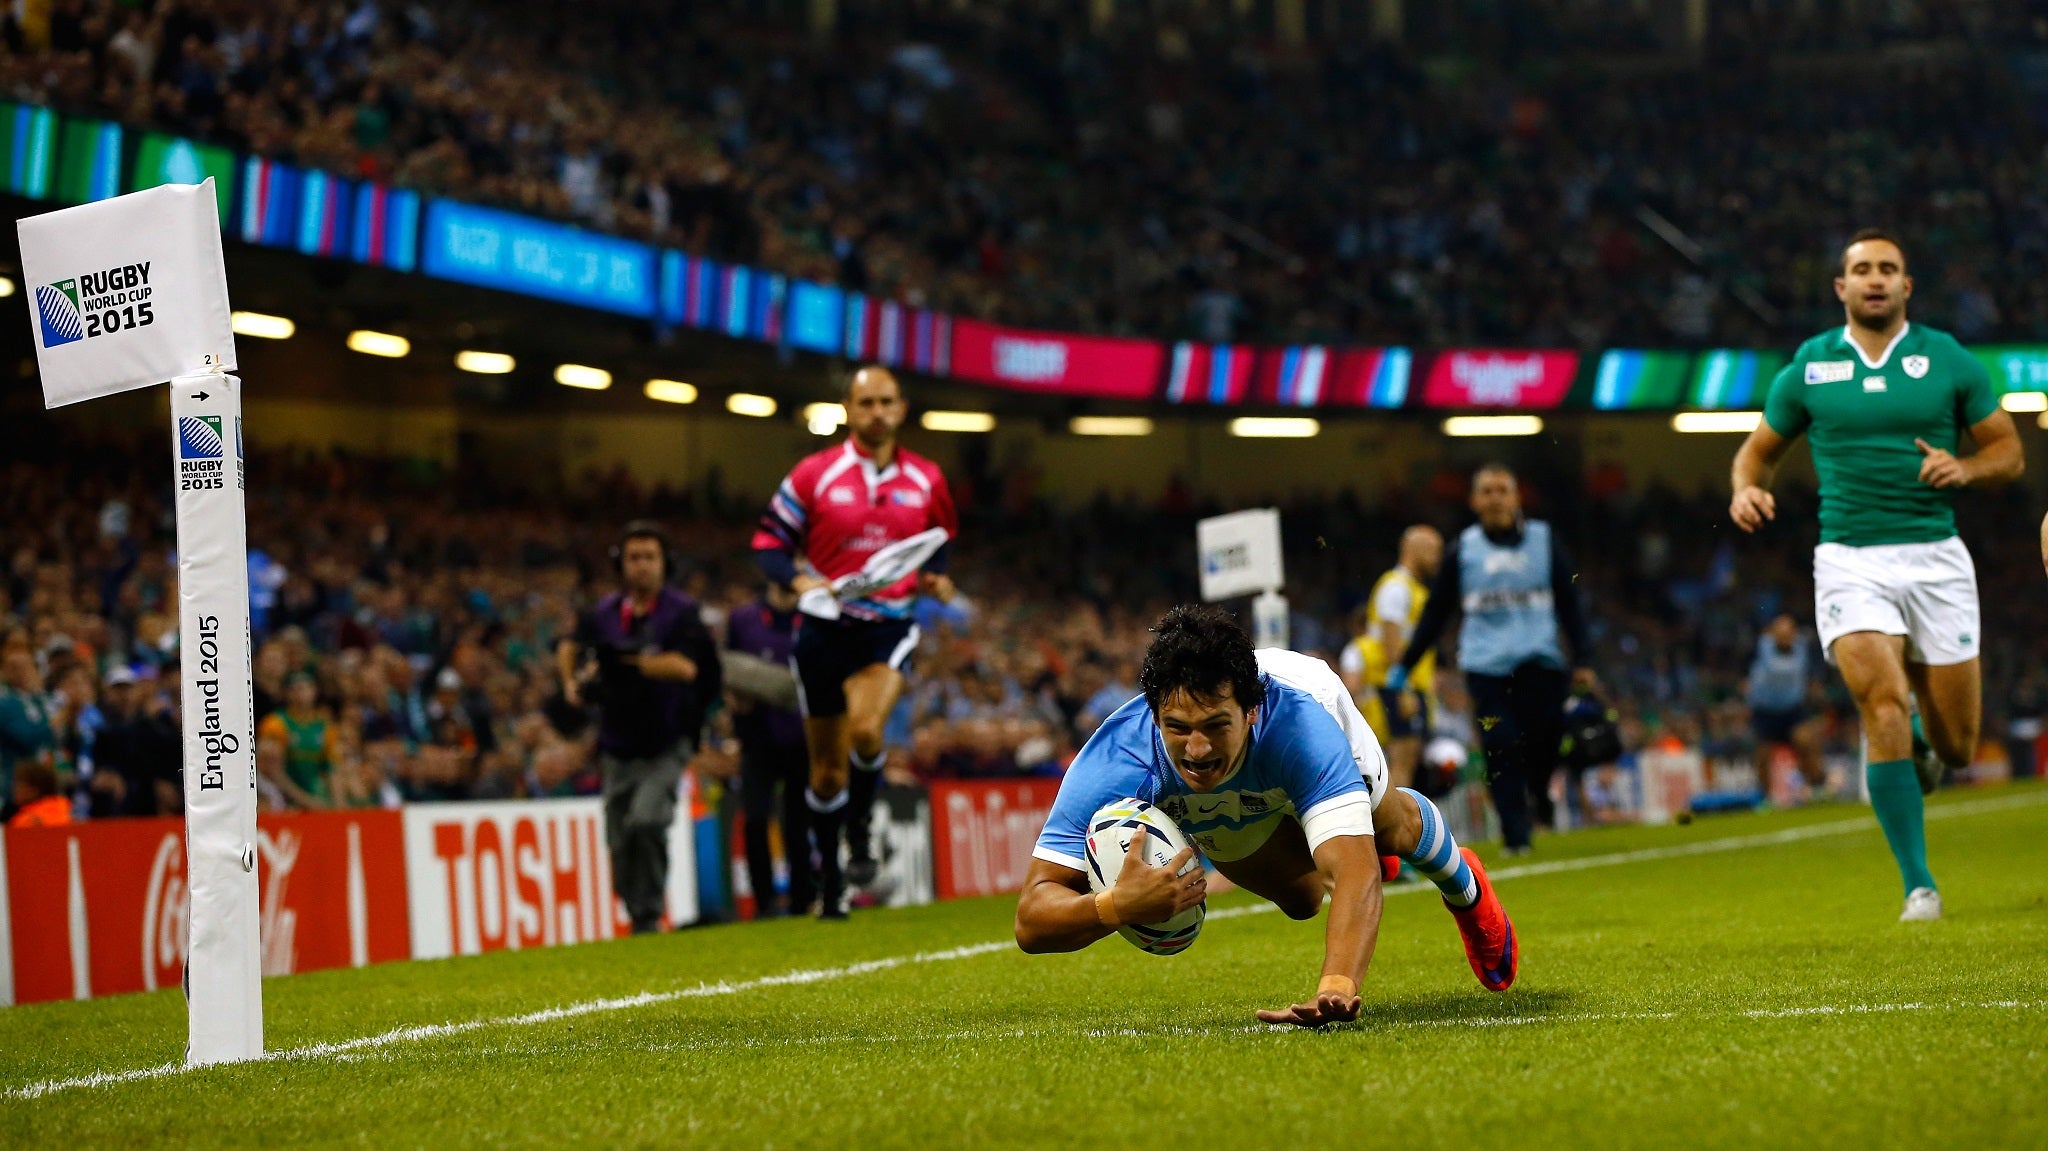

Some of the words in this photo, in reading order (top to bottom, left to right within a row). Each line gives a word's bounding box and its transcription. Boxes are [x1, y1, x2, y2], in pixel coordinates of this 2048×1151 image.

[62, 282, 75, 291] IRB
[80, 261, 150, 298] RUGBY
[83, 292, 126, 312] WORLD
[128, 287, 152, 302] CUP
[85, 302, 154, 338] 2015
[181, 460, 223, 472] RUGBY
[181, 478, 223, 490] 2015
[199, 614, 219, 674] 2015
[197, 678, 239, 791] England
[433, 815, 678, 955] TOSHI
